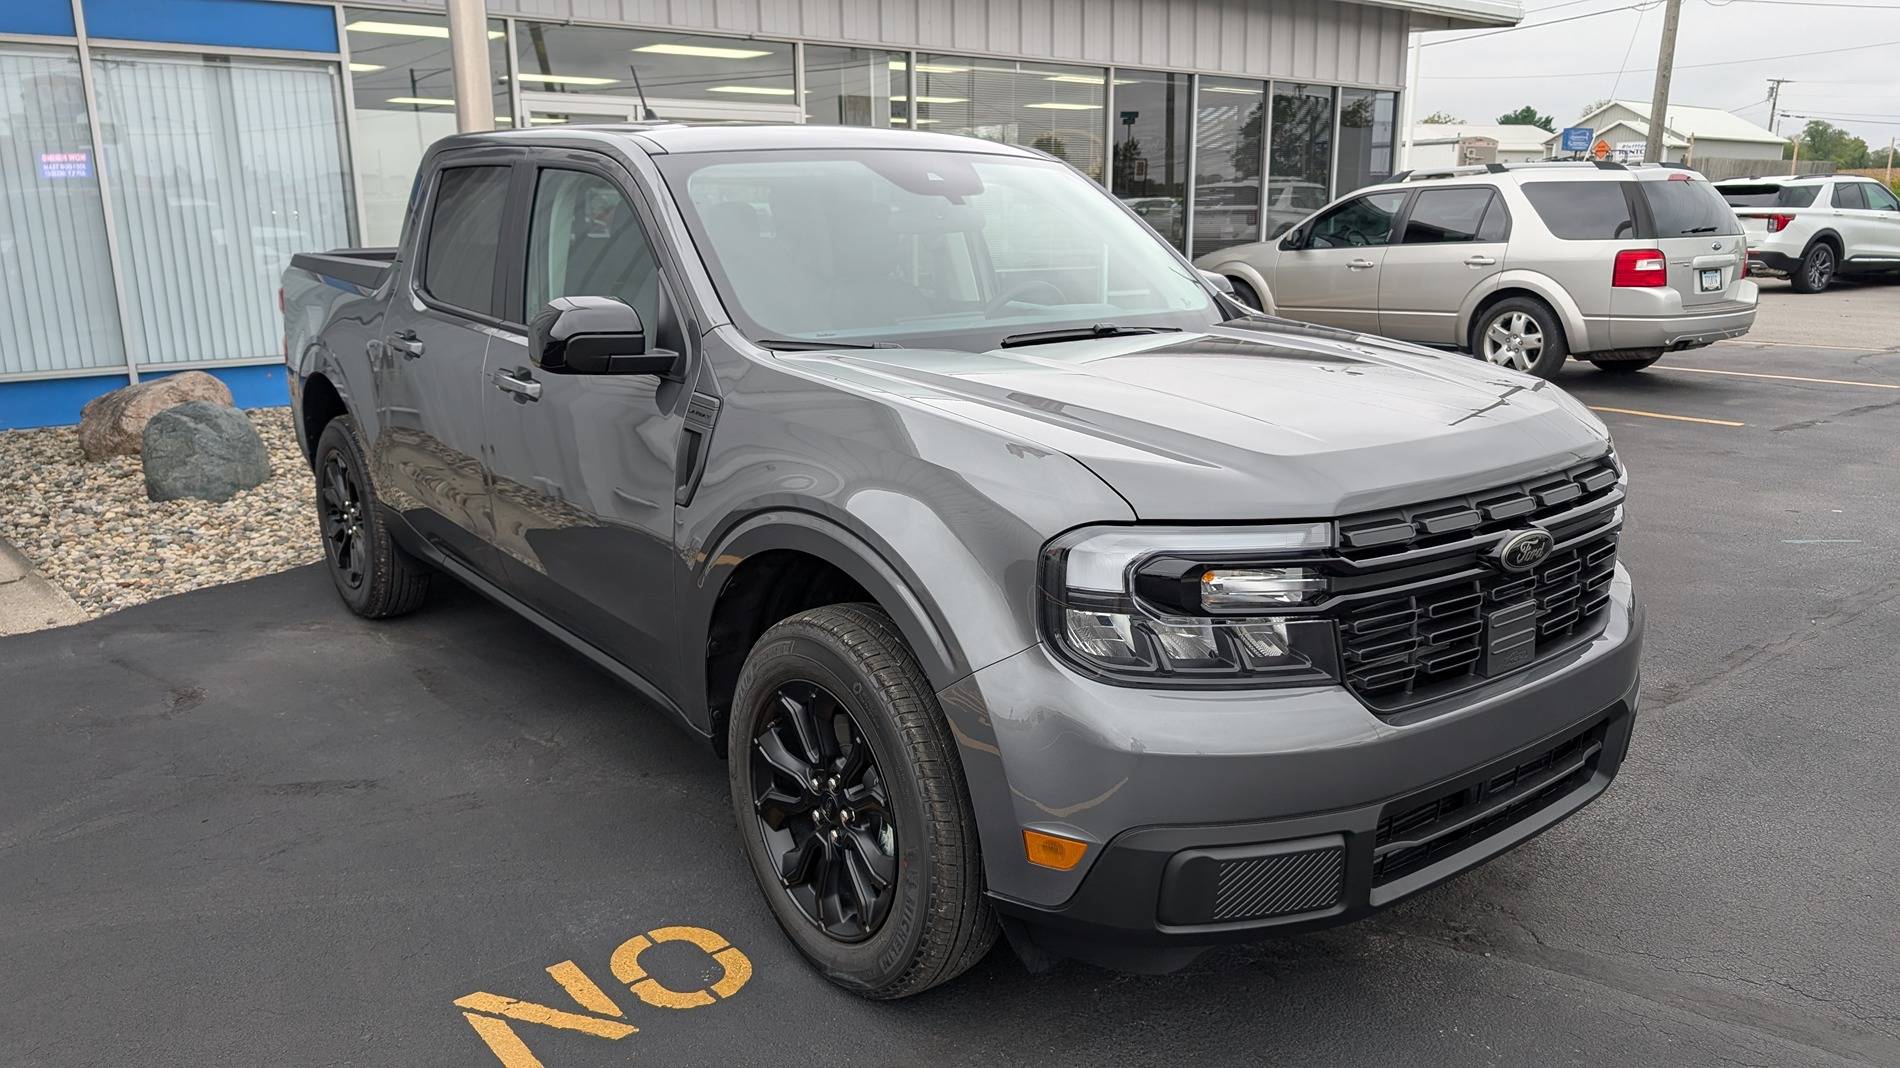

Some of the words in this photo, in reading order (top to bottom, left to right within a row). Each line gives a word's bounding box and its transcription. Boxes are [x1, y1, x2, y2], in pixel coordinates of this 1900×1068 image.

[1516, 539, 1546, 564] Ford
[879, 896, 914, 971] MICHELIN
[452, 926, 752, 1068] NO
